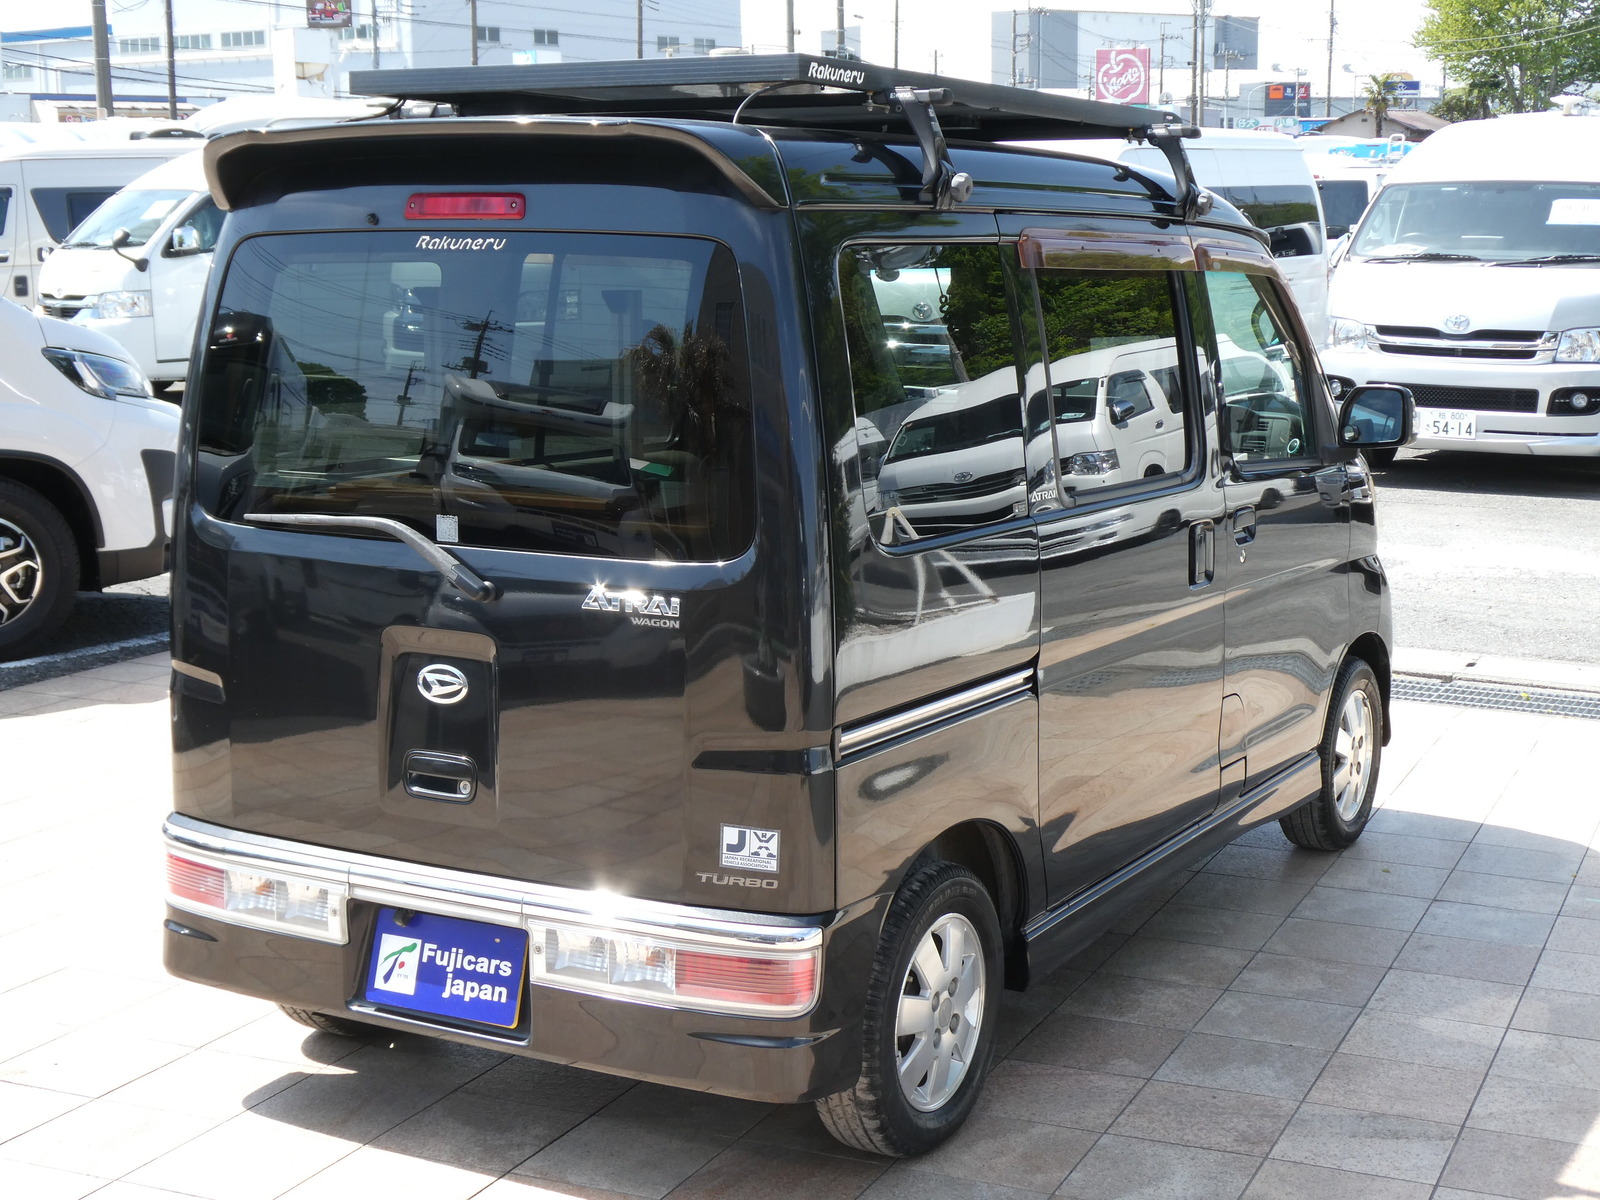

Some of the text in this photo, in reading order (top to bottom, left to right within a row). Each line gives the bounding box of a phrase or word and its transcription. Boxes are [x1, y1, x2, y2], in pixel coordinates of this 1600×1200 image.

[807, 61, 865, 84] Rakuneru
[415, 235, 507, 250] Rakuneru
[1433, 420, 1472, 436] 54-14
[581, 583, 680, 617] ATRAI
[630, 617, 680, 628] WAGON
[696, 872, 779, 889] TURBO
[422, 943, 513, 977] Fujicars
[442, 973, 508, 1004] japan
